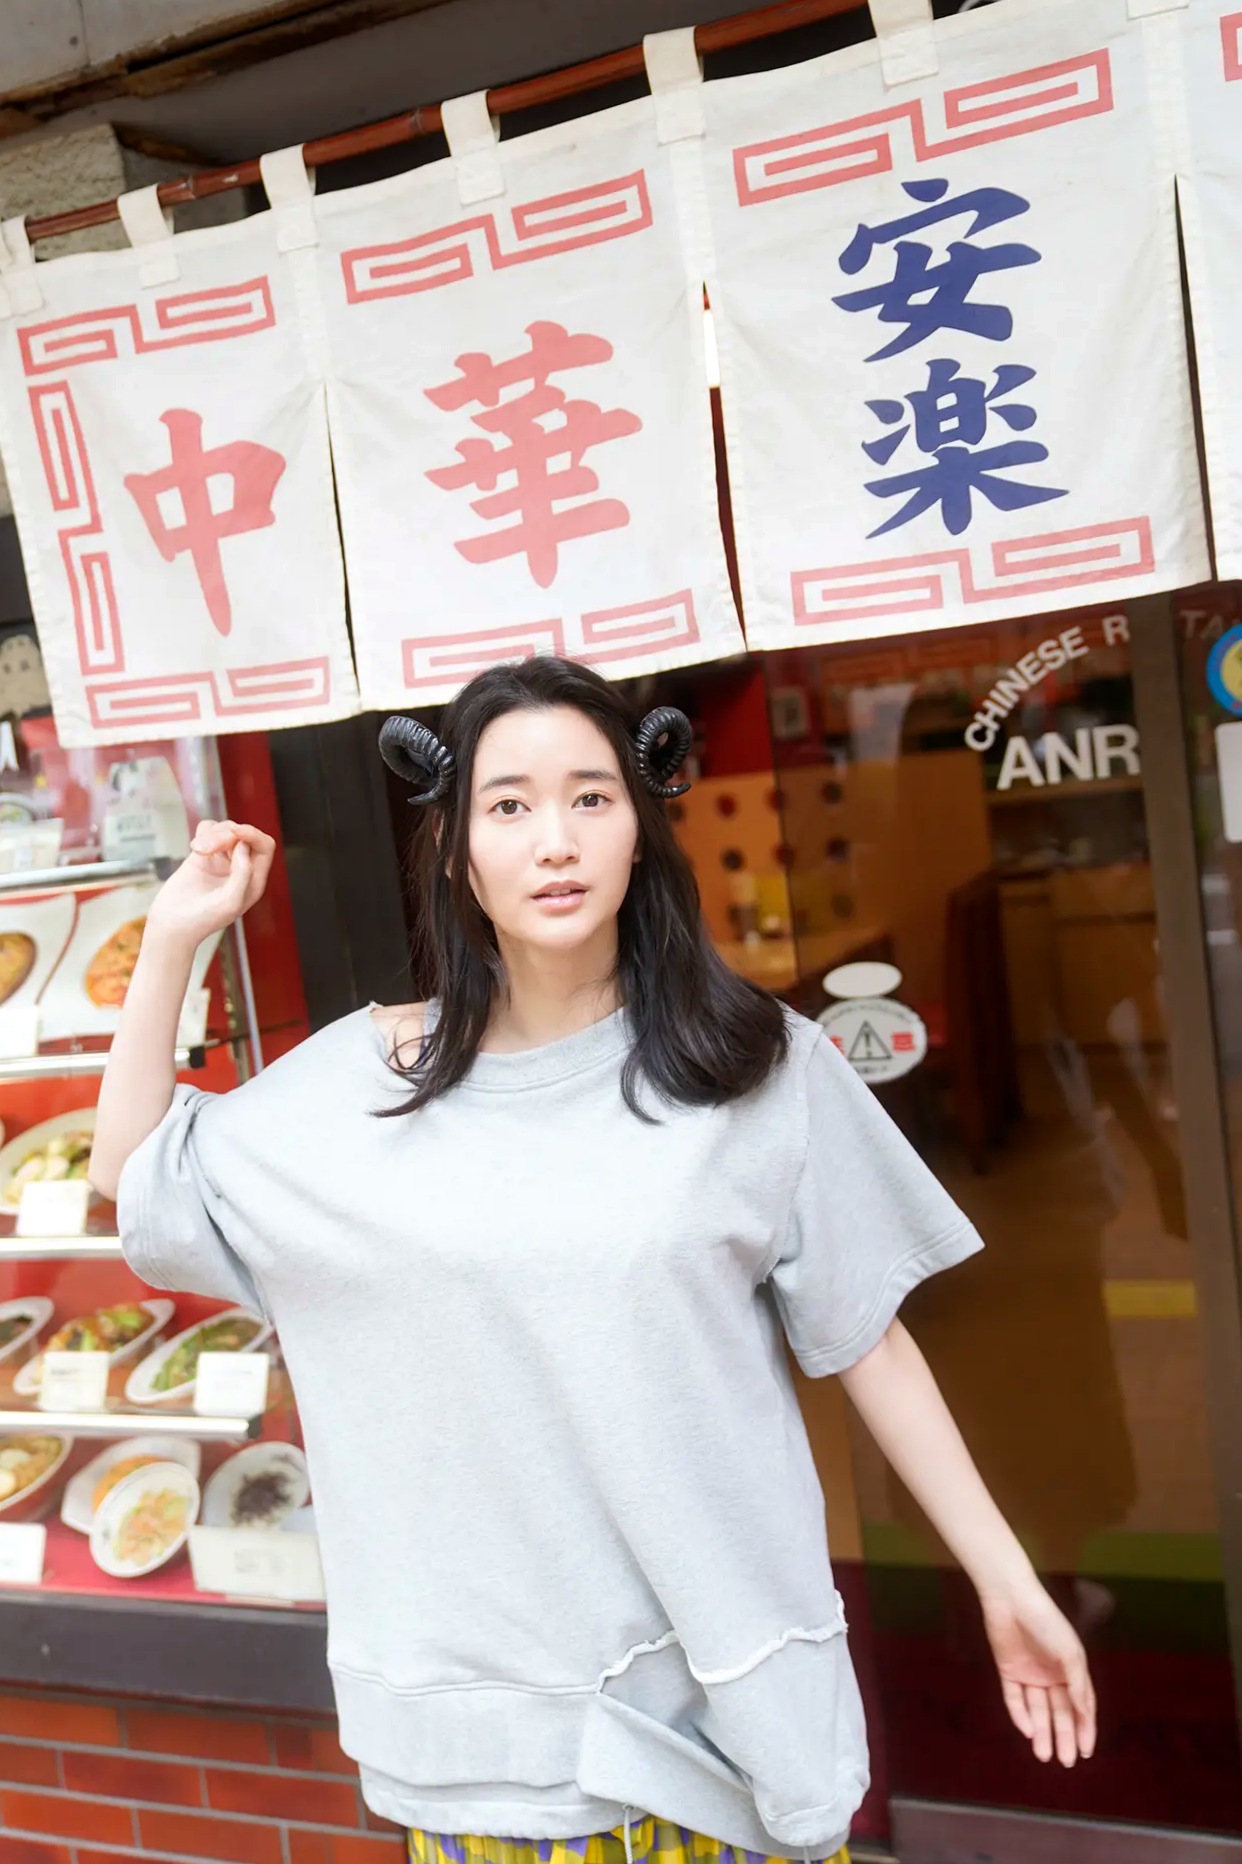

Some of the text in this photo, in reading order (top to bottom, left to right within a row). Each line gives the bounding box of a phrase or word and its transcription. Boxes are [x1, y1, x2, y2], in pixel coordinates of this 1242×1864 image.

[831, 177, 1070, 540] 安楽
[964, 626, 1090, 752] CHINESE
[996, 723, 1141, 791] ANR
